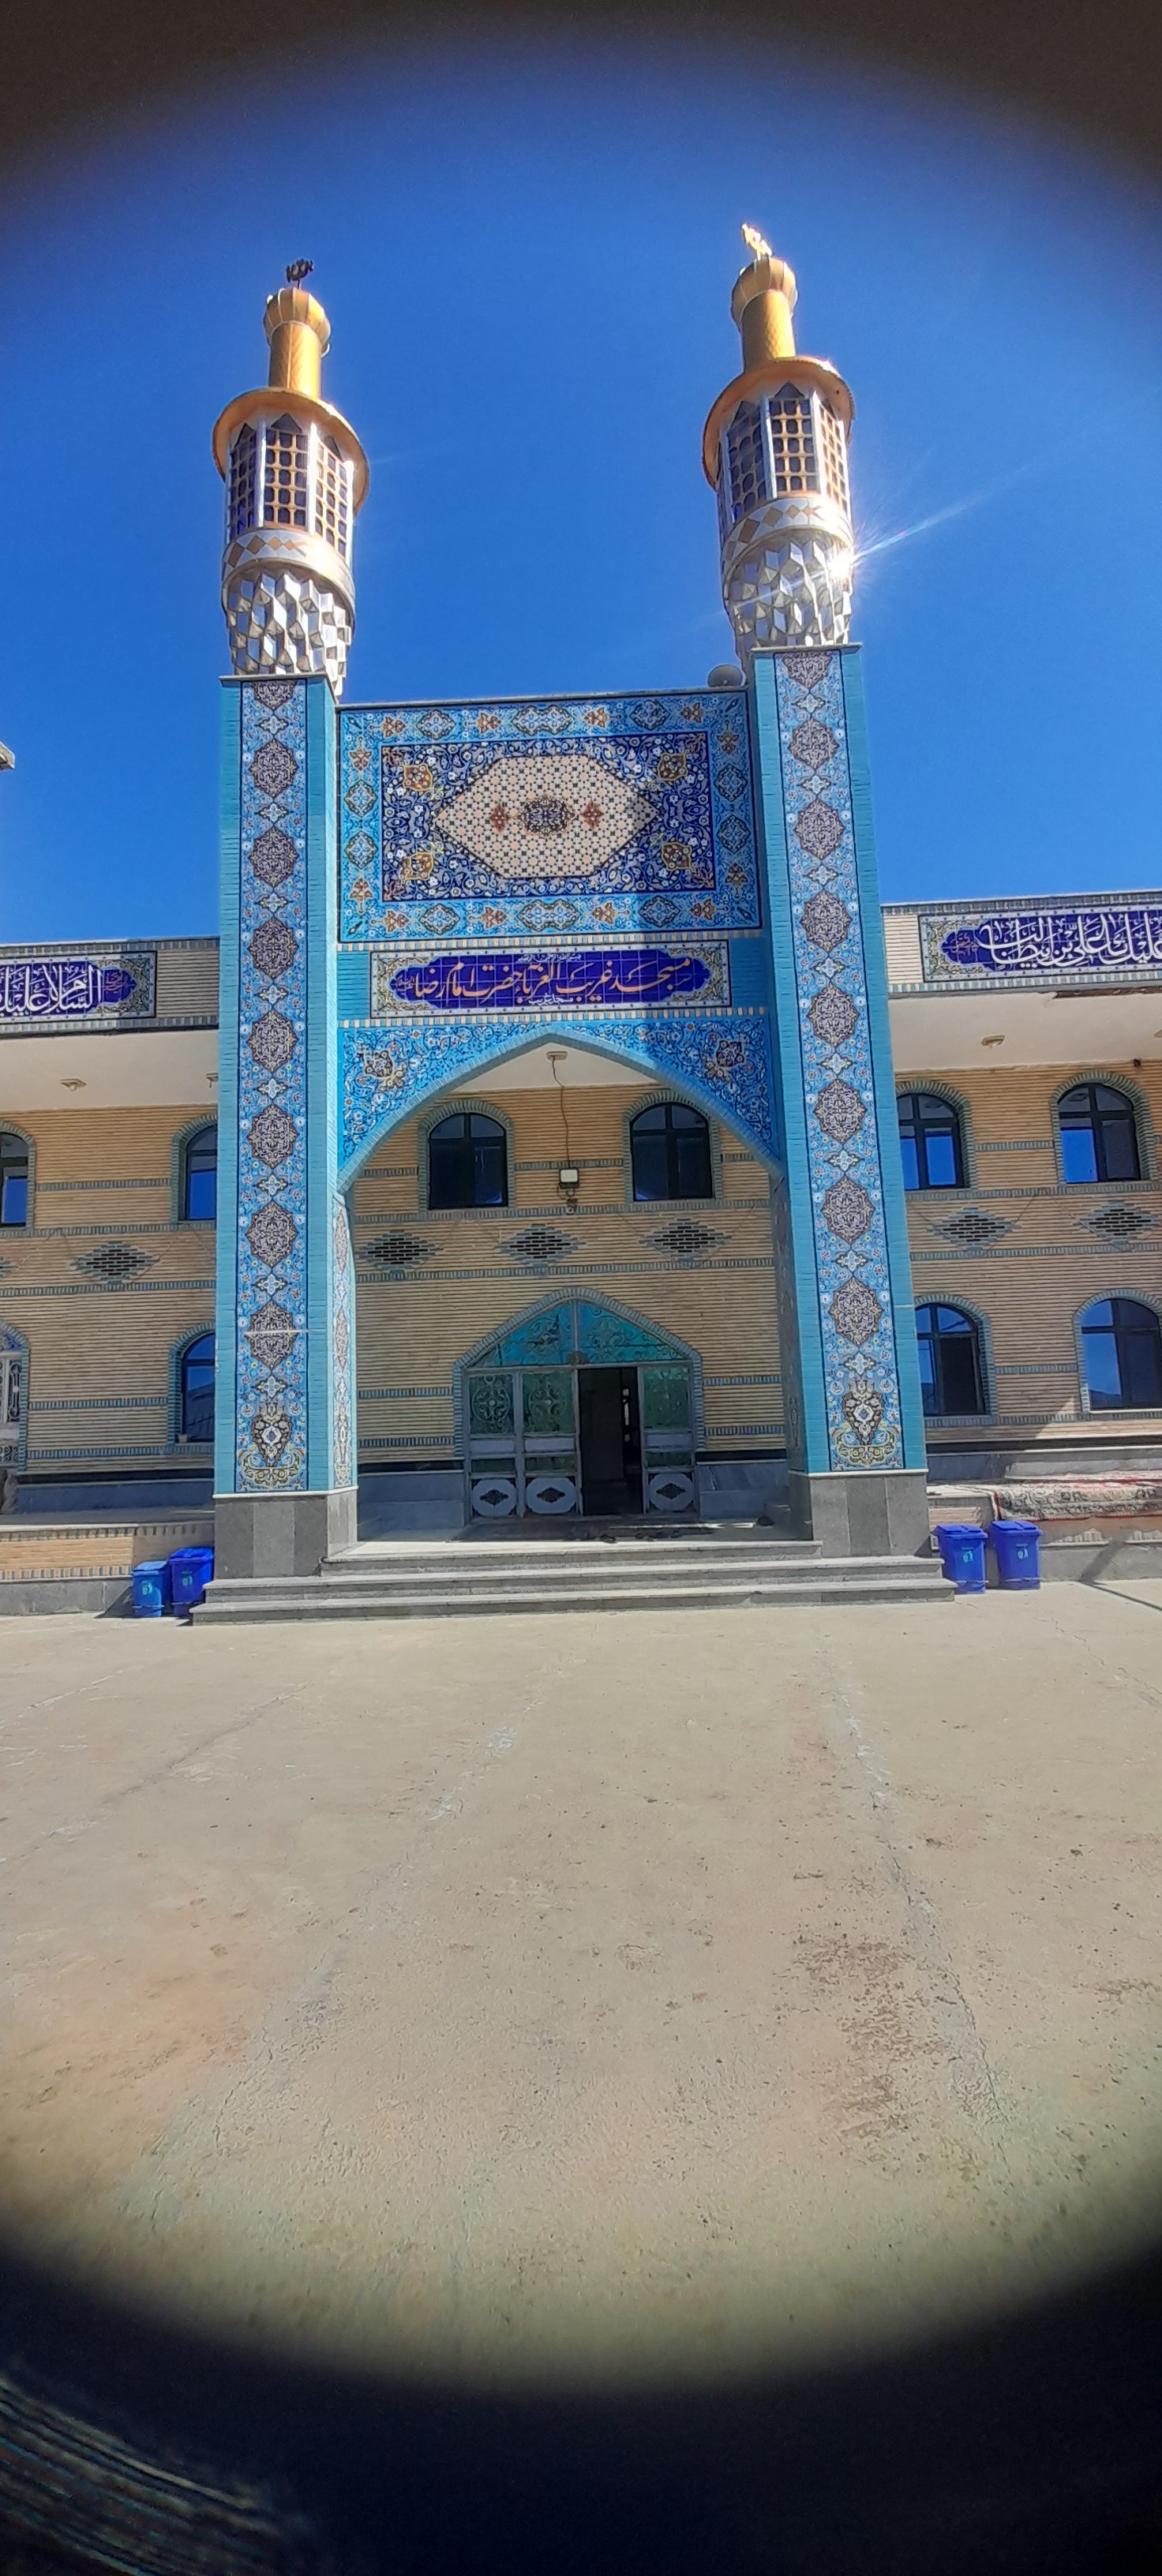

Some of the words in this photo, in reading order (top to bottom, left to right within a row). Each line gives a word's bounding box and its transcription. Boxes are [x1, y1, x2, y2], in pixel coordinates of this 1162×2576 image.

[41, 964, 103, 1015] السلام
[414, 967, 445, 998] رضا
[445, 961, 474, 1007] امام
[462, 965, 523, 1004] حضرت
[556, 960, 613, 1002] غریب
[609, 957, 692, 991] مسجد
